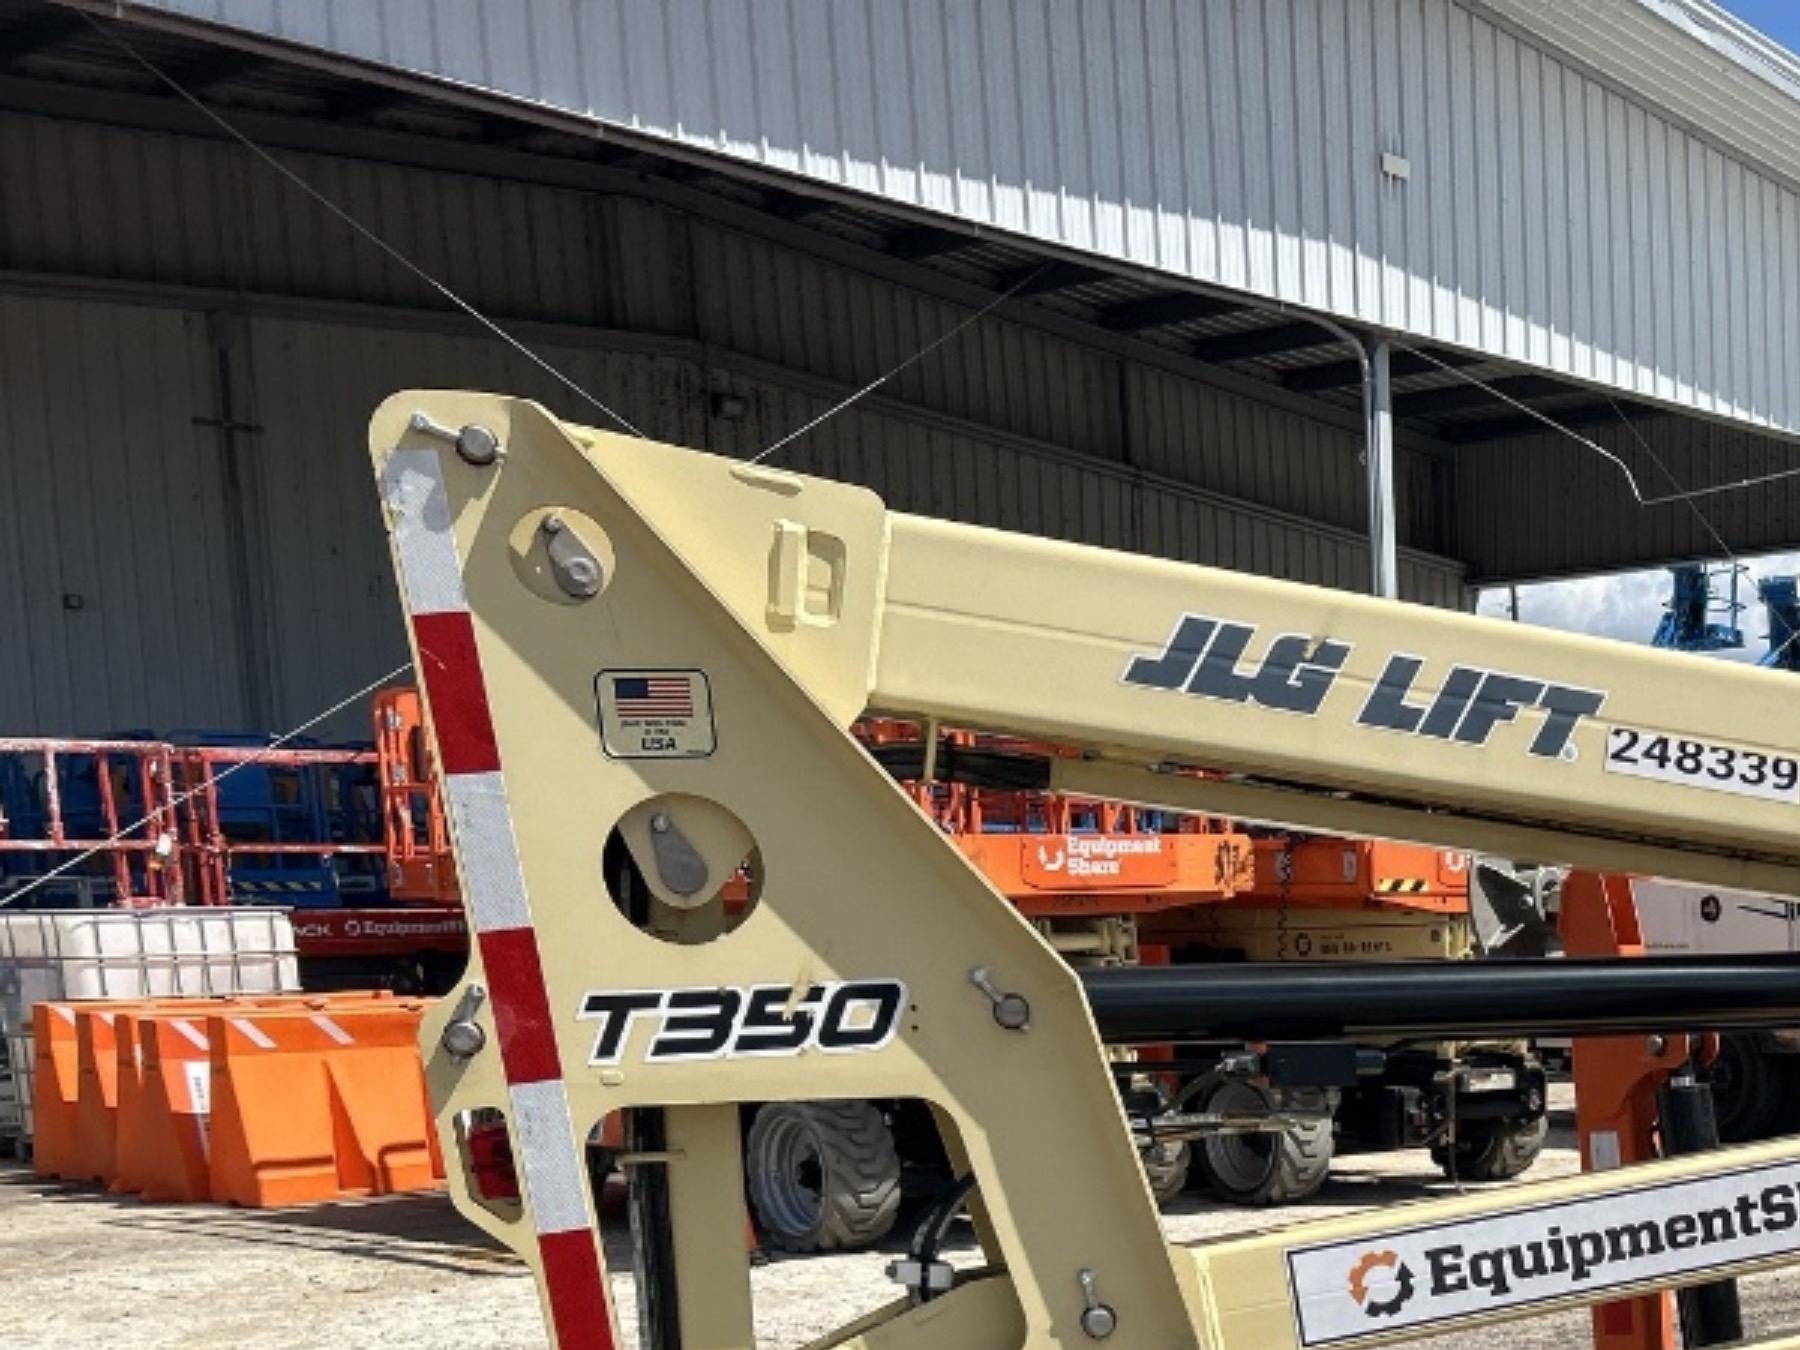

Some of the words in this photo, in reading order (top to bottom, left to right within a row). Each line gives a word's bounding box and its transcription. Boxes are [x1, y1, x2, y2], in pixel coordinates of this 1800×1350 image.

[1120, 612, 1355, 717] JLG
[1354, 651, 1607, 761] LIFT
[641, 737, 677, 751] USA
[1609, 727, 1799, 791] 248339
[1067, 835, 1162, 858] Equipment
[1067, 857, 1121, 875] Share
[580, 980, 904, 1063] T350
